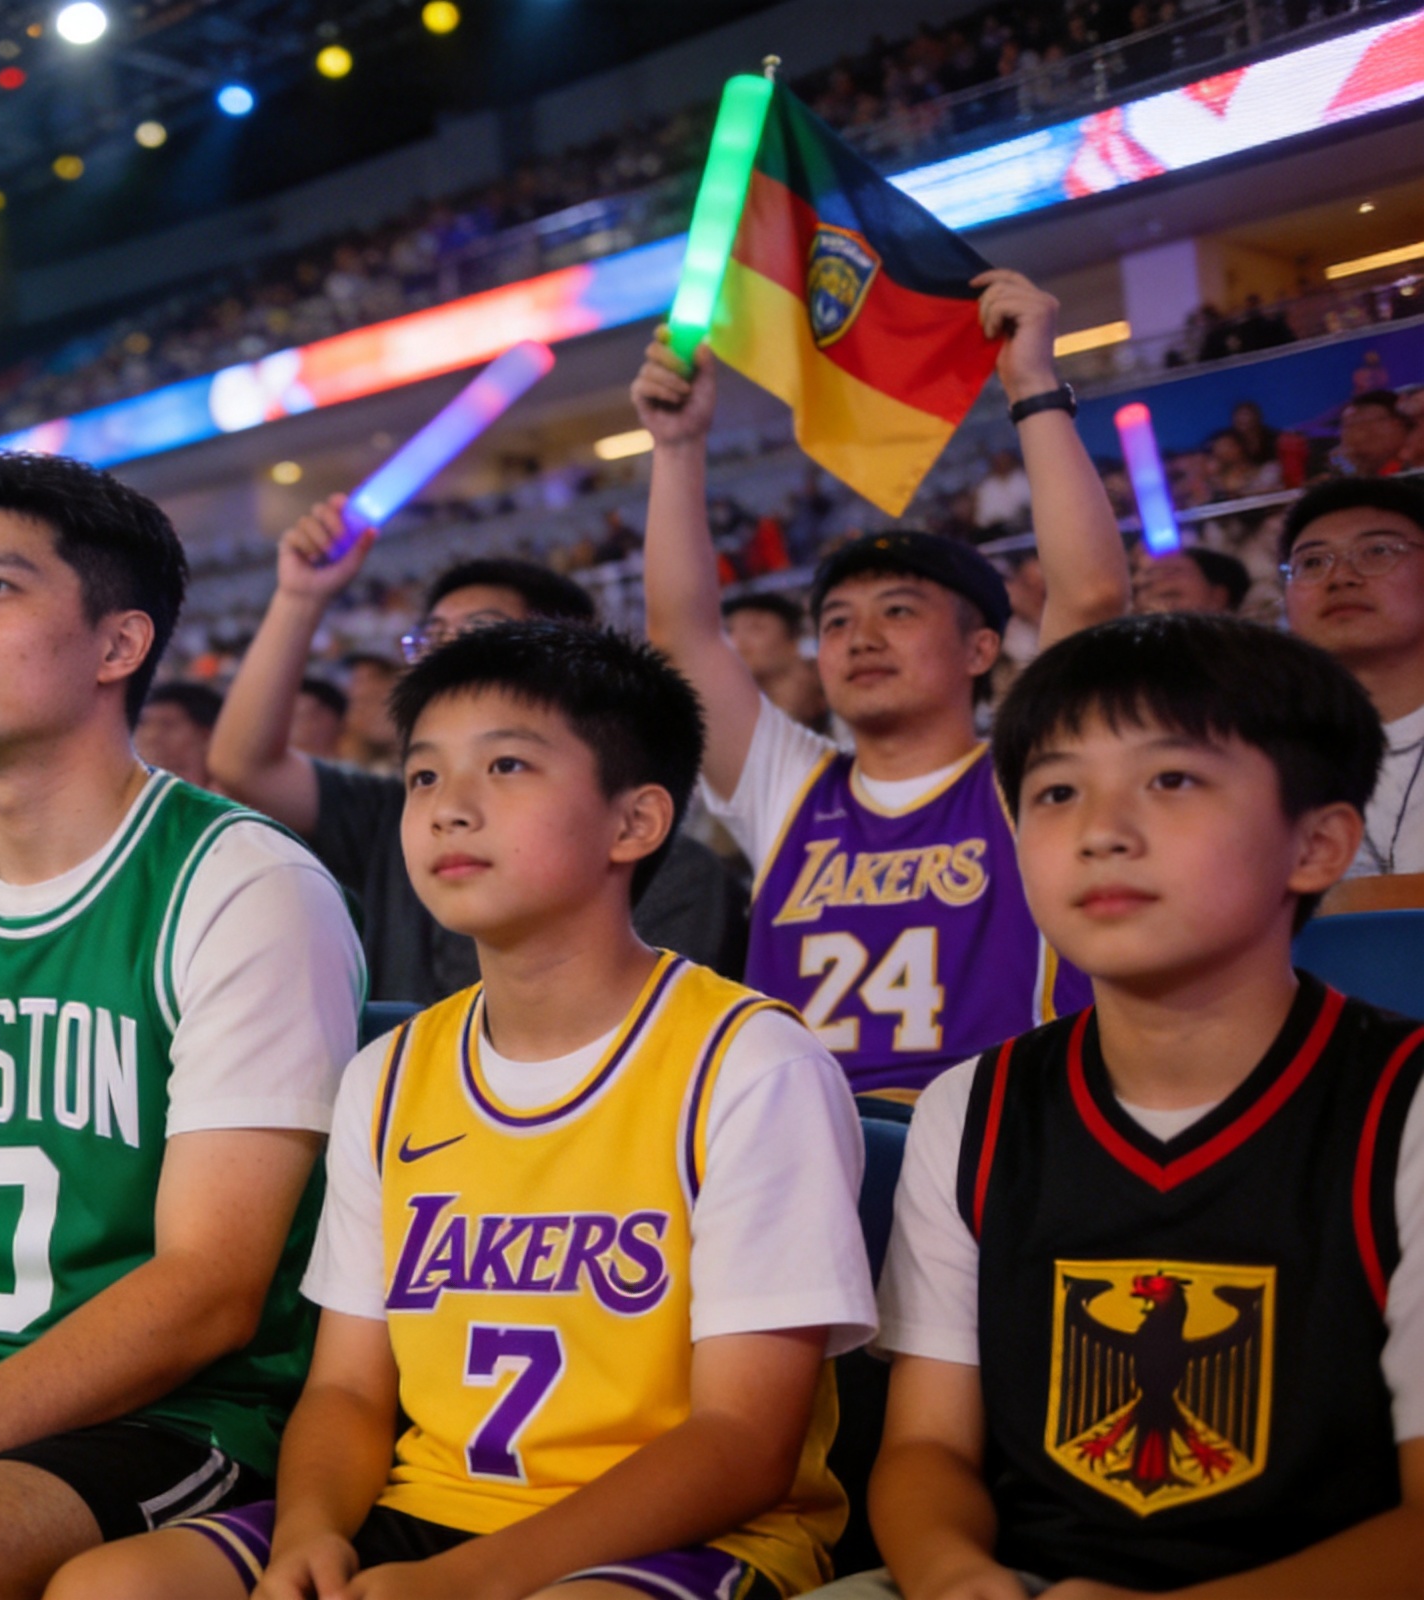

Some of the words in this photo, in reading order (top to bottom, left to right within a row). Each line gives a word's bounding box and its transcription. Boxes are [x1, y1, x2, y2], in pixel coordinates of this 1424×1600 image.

[771, 838, 990, 927] LAKERS
[799, 926, 945, 1052] 24
[384, 1192, 673, 1318] LAKERS
[463, 1321, 567, 1486] 7
